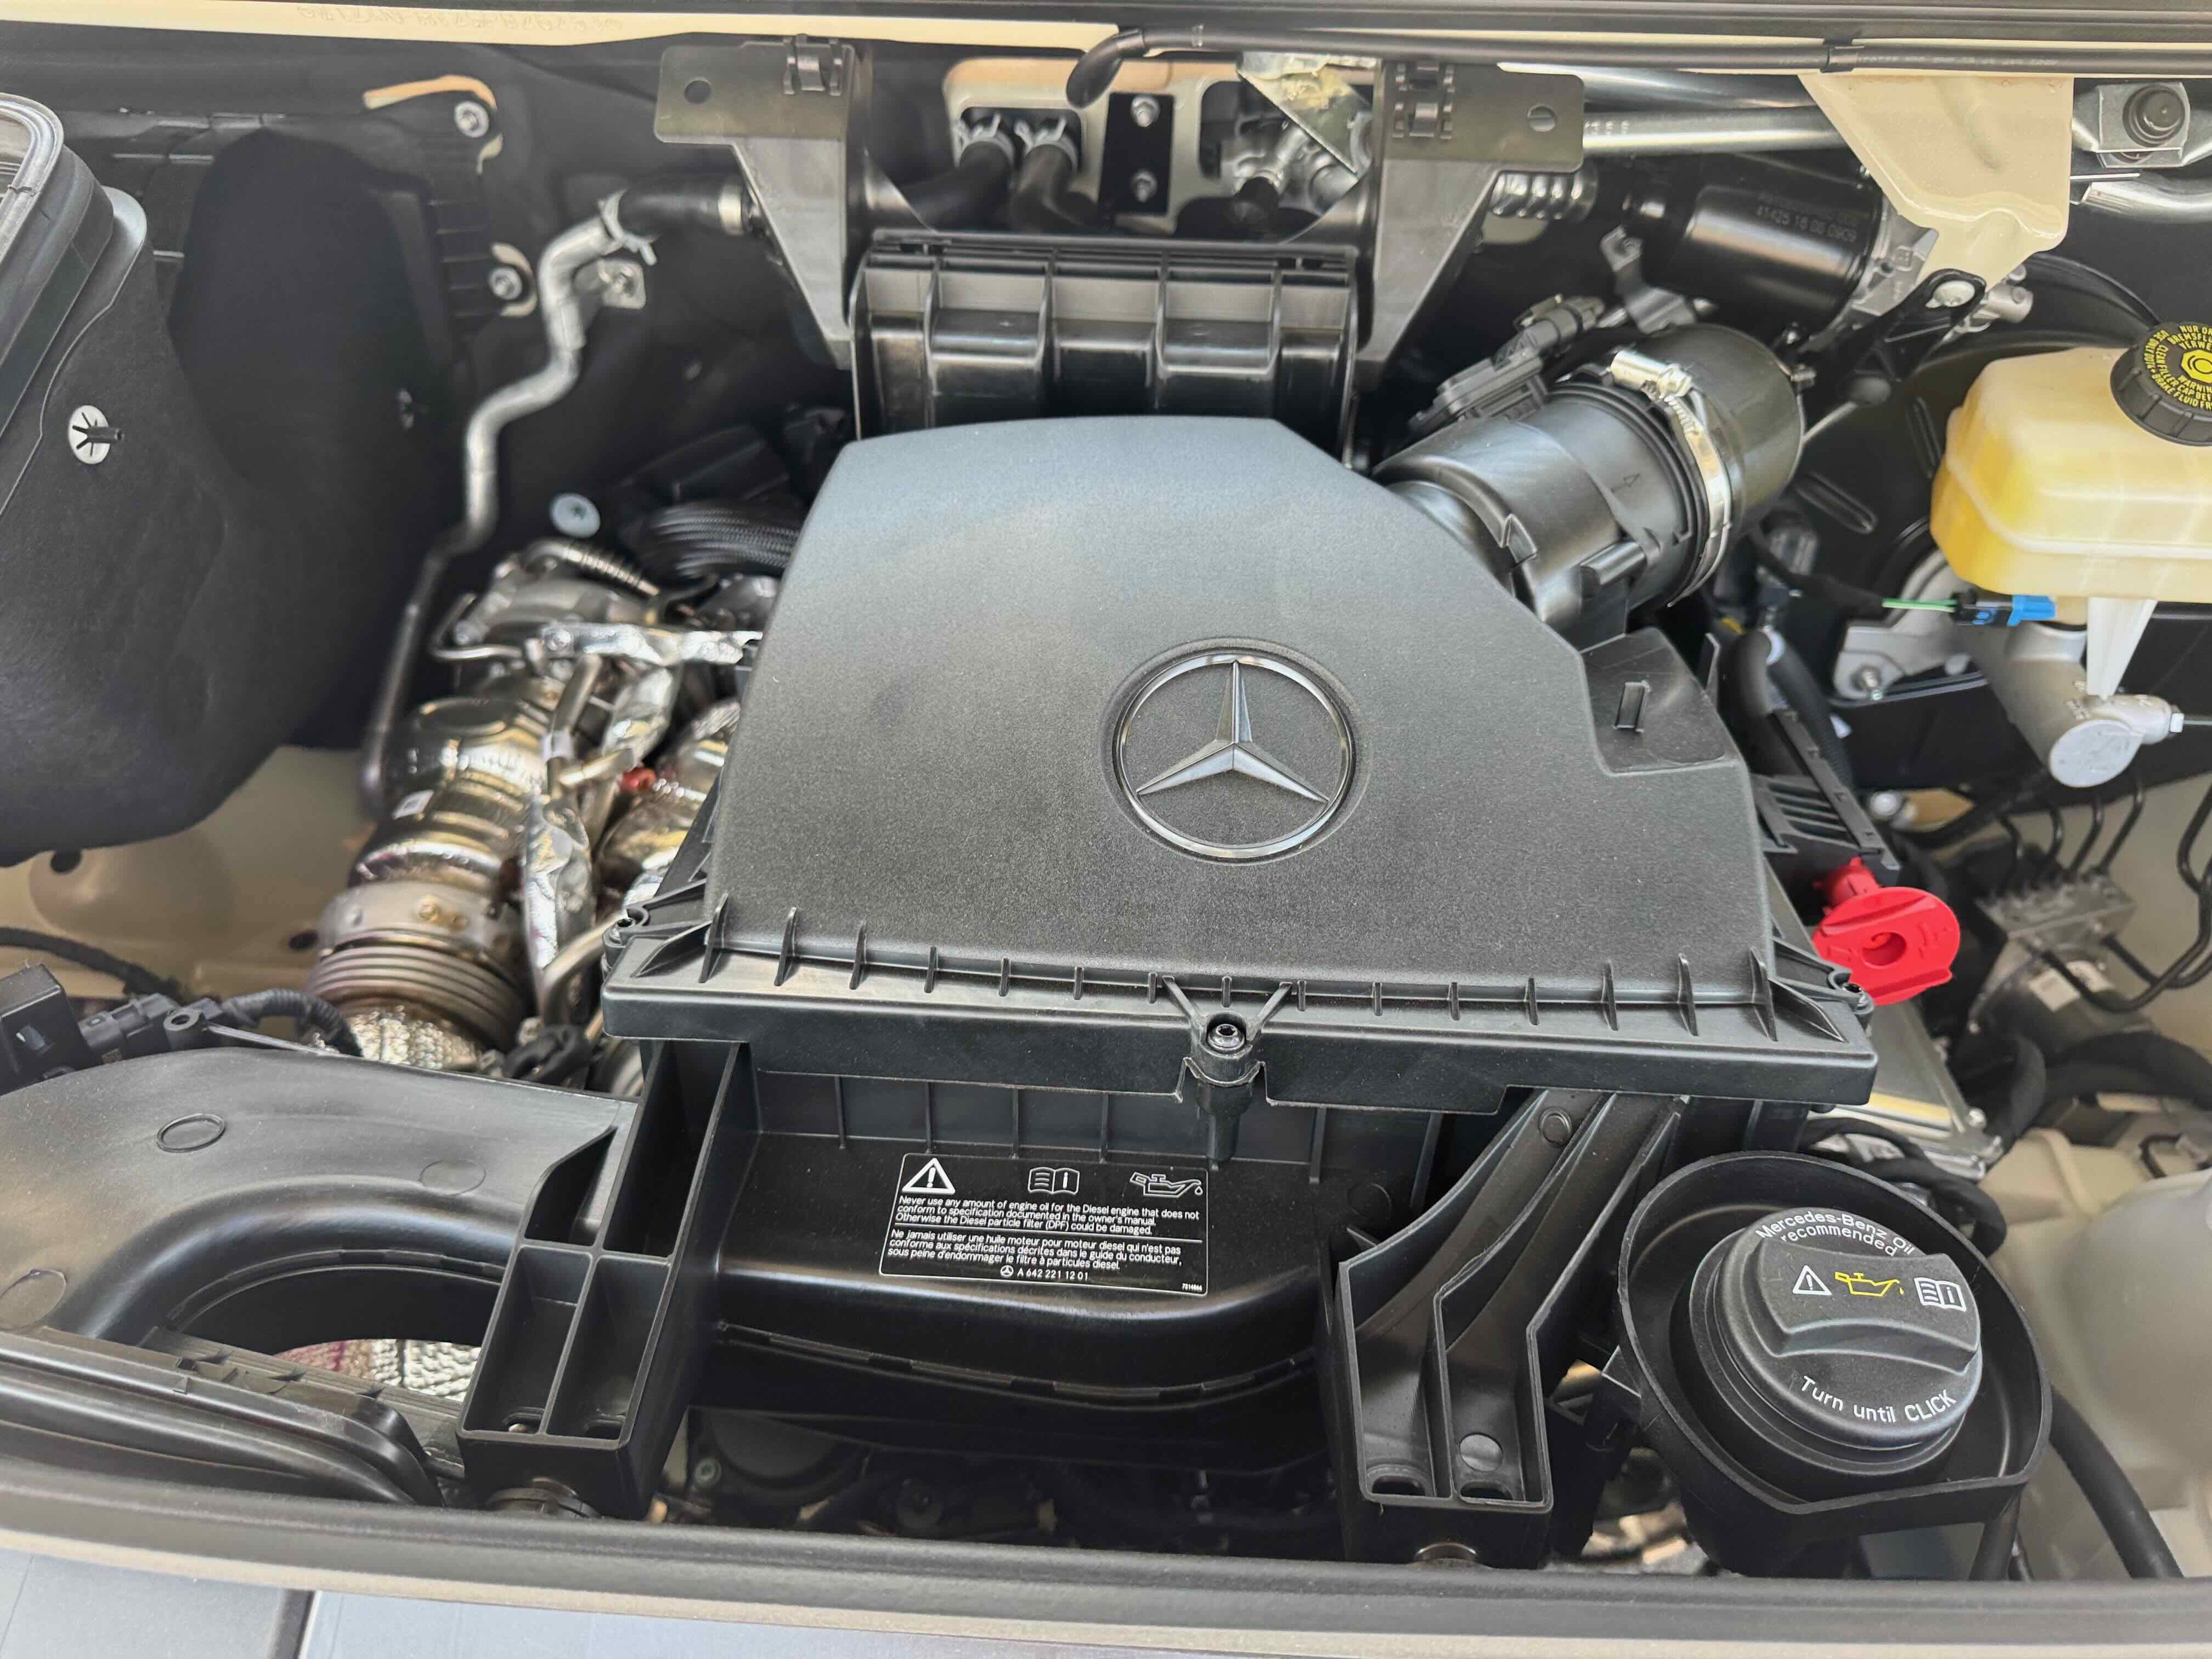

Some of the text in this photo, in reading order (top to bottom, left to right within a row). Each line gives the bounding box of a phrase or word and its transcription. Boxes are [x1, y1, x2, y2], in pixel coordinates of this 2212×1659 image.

[2179, 325, 2199, 333] NUR
[2172, 391, 2199, 407] FLUID
[2200, 400, 2212, 411] FR
[2177, 384, 2195, 396] CAP
[898, 1205, 935, 1214] conform
[949, 1207, 1004, 1217] specification
[1006, 1209, 1060, 1220] documented
[1063, 1212, 1069, 1221] in
[1072, 1212, 1086, 1221] the
[1088, 1214, 1122, 1223] owner's
[1125, 1216, 1156, 1226] manual.
[899, 1195, 926, 1205] Never
[945, 1199, 960, 1207] any
[963, 1199, 995, 1208] amount
[997, 1200, 1007, 1209] of
[1009, 1201, 1037, 1211] engine
[1040, 1202, 1049, 1211] oil
[1051, 1203, 1063, 1212] for
[1067, 1204, 1080, 1212] the
[1083, 1204, 1109, 1214] Diesel
[1111, 1207, 1139, 1216] engine
[1142, 1208, 1159, 1217] that
[1161, 1209, 1182, 1219] does
[1185, 1211, 1199, 1220] not
[895, 1212, 1152, 1235] Otherwise the Diesel particle filter (DPF) could be damaged.
[1756, 1211, 1915, 1255] Mercedes-Benz Oil
[889, 1239, 933, 1249] conforme
[936, 1241, 951, 1250] aux
[953, 1242, 1015, 1254] spécifications
[1057, 1248, 1077, 1257] dans
[1080, 1249, 1086, 1258] le
[1090, 1249, 1113, 1260] guide
[1116, 1251, 1127, 1261] du
[1129, 1252, 1182, 1266] conducteur,
[891, 1229, 1181, 1256] Ne jamais utiliser une huile moteur pour moteur diesel qui n'est pas
[1781, 1225, 1899, 1257] recommended
[888, 1248, 1120, 1270] sous peine d'endommager le filtre à particules diesel.
[1017, 1268, 1088, 1280] A 642 221 12 01
[1801, 1375, 1956, 1423] Turn until CLICK
